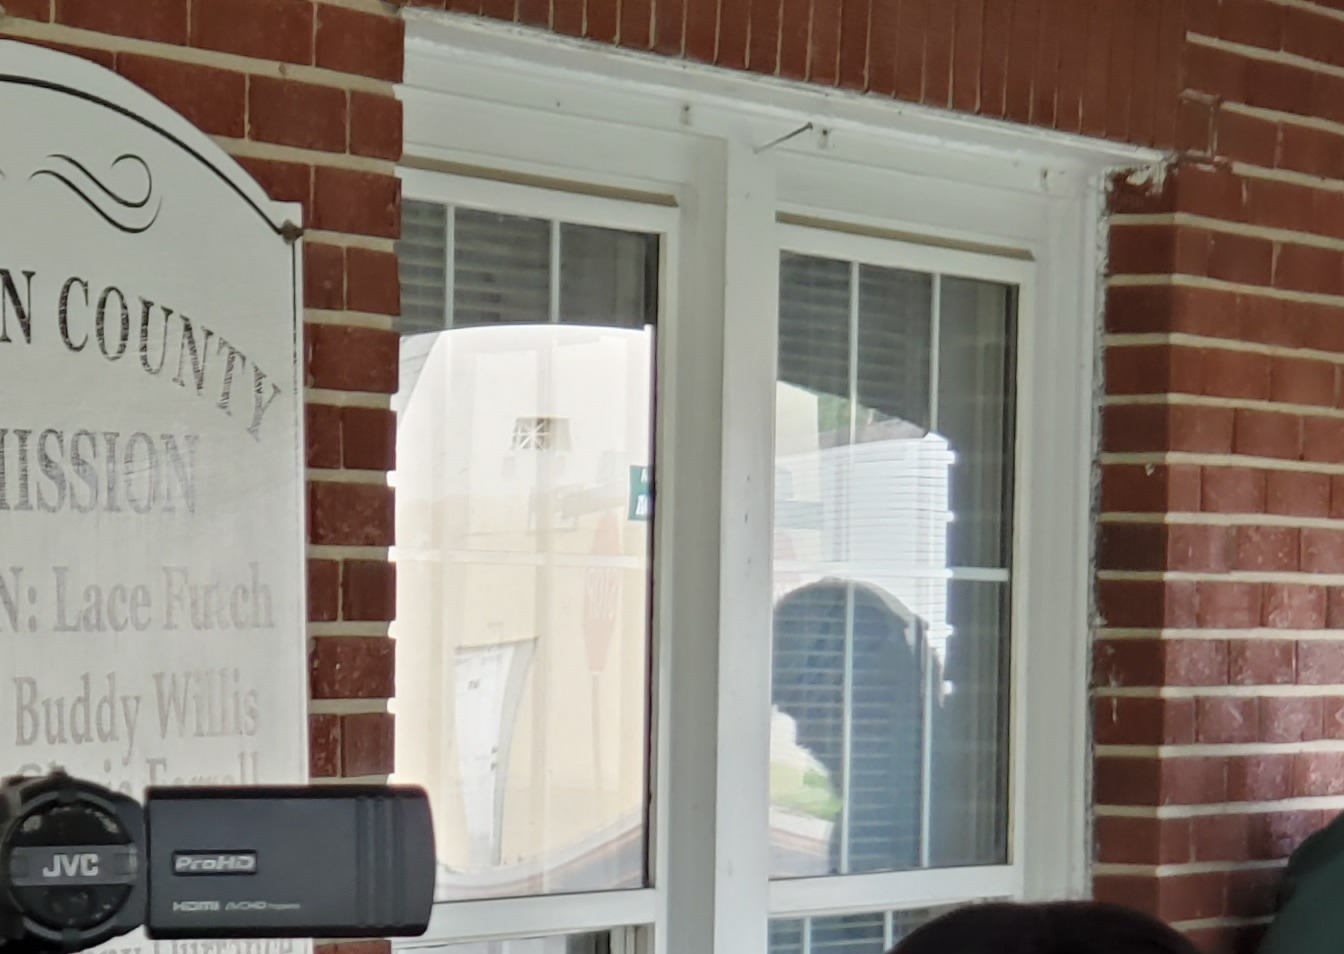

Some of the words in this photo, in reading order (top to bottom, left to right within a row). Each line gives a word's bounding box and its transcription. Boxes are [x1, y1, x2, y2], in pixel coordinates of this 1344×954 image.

[56, 276, 283, 442] COUNTY
[52, 564, 153, 633] Lace
[12, 672, 142, 766] Buddy
[152, 667, 257, 740] Willis
[42, 853, 99, 877] JVC
[175, 855, 256, 871] ProHD
